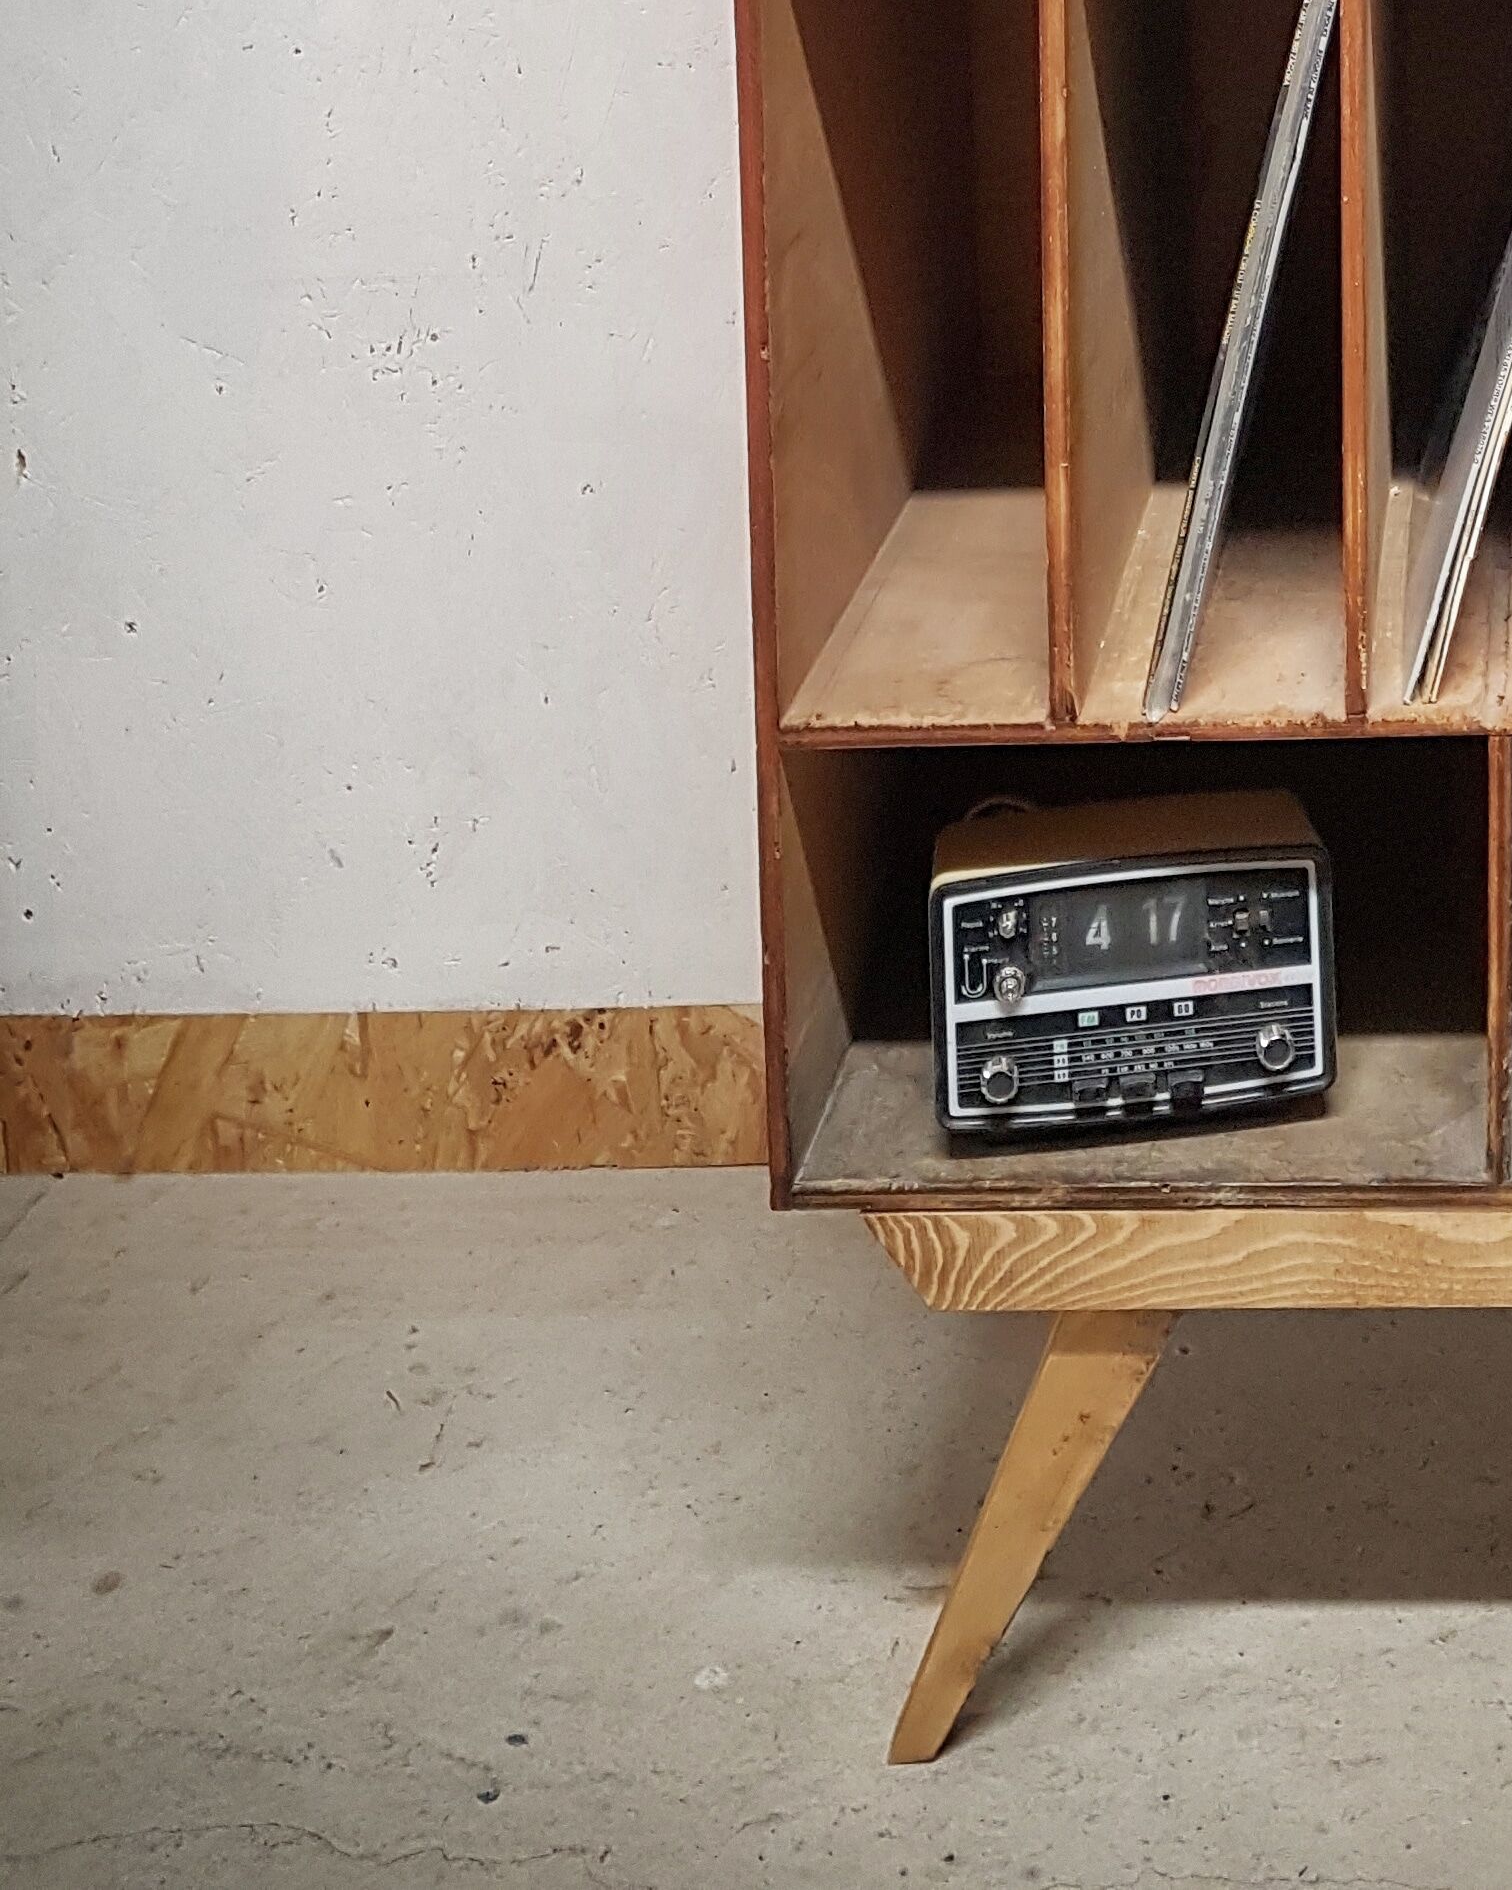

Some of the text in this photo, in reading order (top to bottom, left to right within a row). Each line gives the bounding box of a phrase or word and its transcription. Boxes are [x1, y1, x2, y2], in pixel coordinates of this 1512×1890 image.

[1085, 905, 1111, 950] 4
[1142, 894, 1188, 946] 17
[1130, 1009, 1142, 1019] PO
